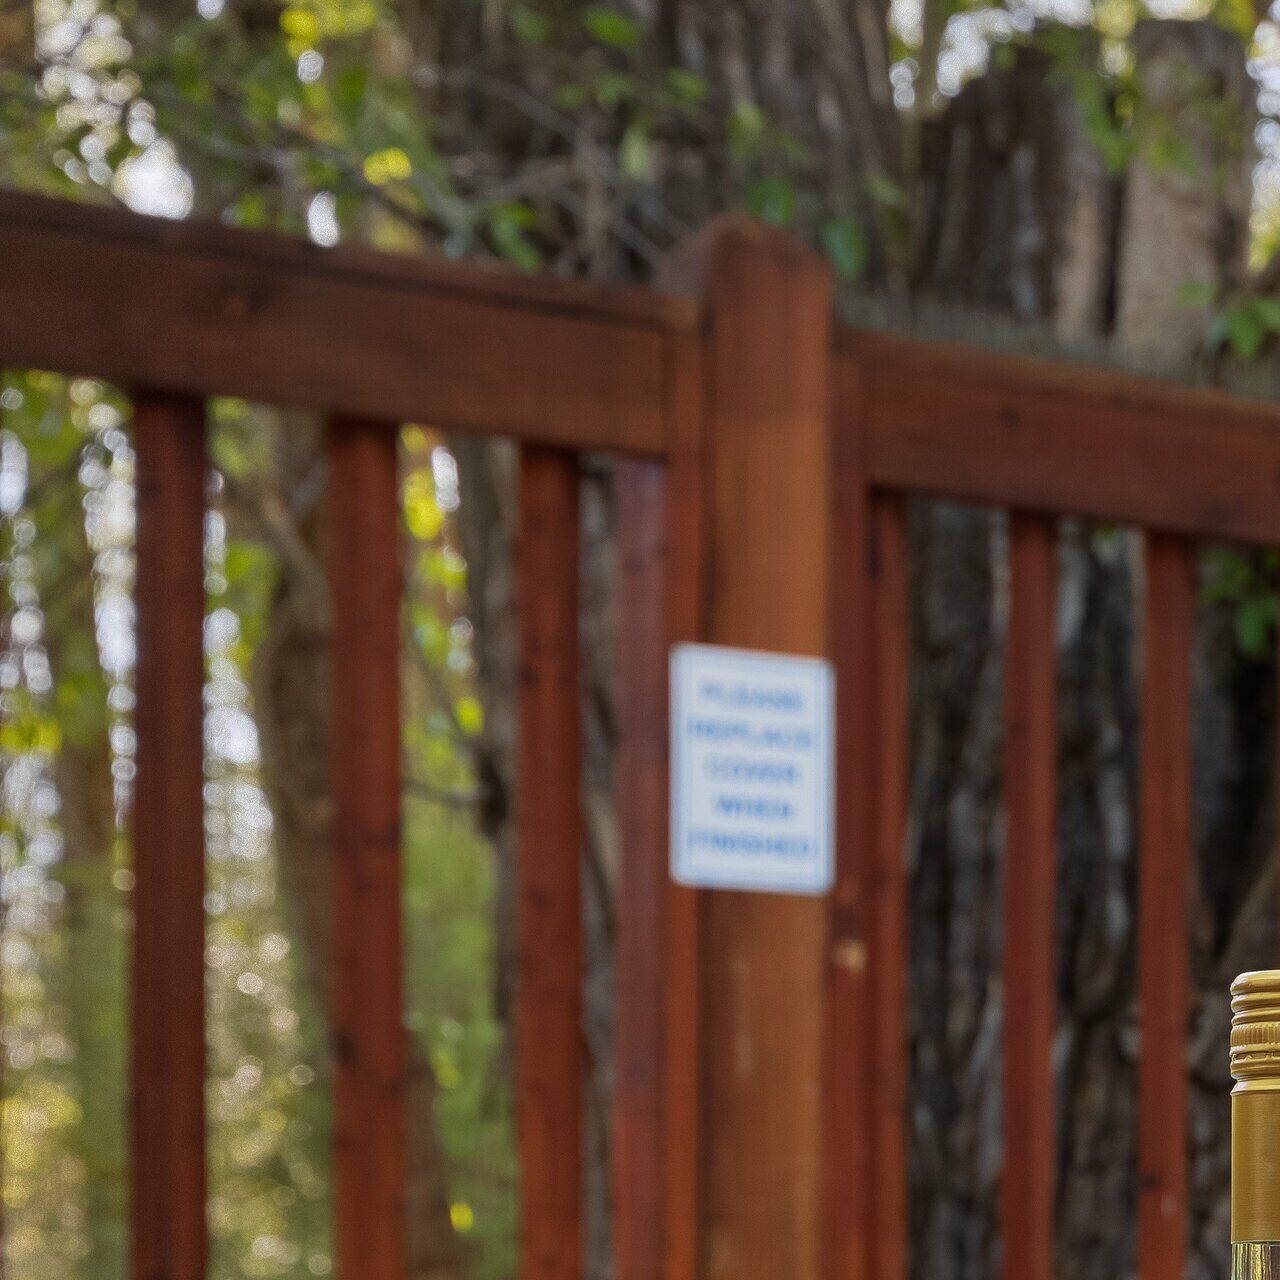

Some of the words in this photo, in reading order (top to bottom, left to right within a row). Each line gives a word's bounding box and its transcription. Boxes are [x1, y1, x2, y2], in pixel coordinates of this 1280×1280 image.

[700, 680, 802, 710] PLEASE
[687, 717, 811, 748] REPLACE
[705, 753, 798, 782] COVER
[714, 792, 794, 821] WHEN
